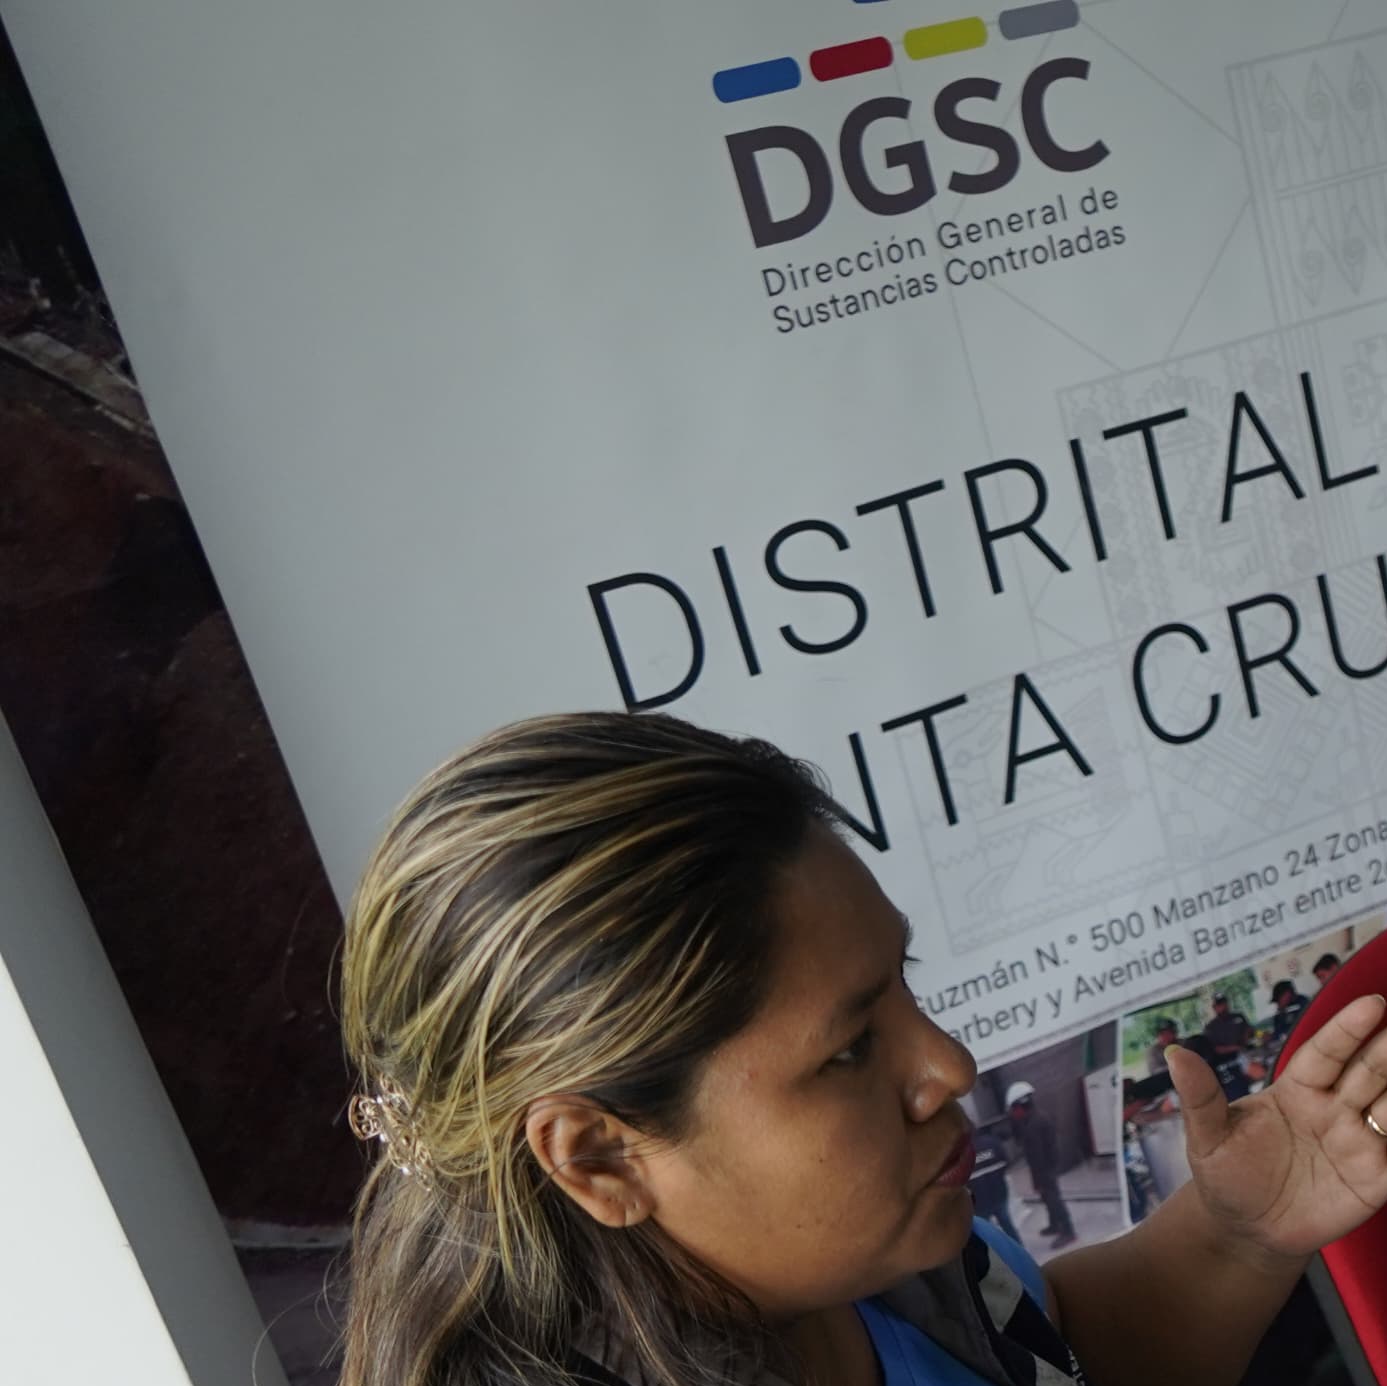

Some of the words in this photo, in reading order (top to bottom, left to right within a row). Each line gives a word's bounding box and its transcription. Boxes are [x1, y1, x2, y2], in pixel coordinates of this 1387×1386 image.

[725, 57, 1110, 248] DGSC
[762, 236, 925, 296] Dirección
[937, 195, 1067, 249] General
[1081, 188, 1117, 215] de
[774, 273, 937, 333] Sustancias
[945, 226, 1125, 285] Controladas
[587, 372, 1379, 720] DISTRITAL
[828, 673, 1093, 852] NTA
[949, 1000, 1038, 1043] arbery
[1048, 993, 1061, 1018] y
[1075, 944, 1185, 1002] Avenida
[1193, 902, 1285, 955] Banzer
[1294, 874, 1361, 914] entre
[1090, 912, 1144, 952] 500
[1153, 866, 1278, 928] Manzano
[1286, 846, 1320, 877] 24
